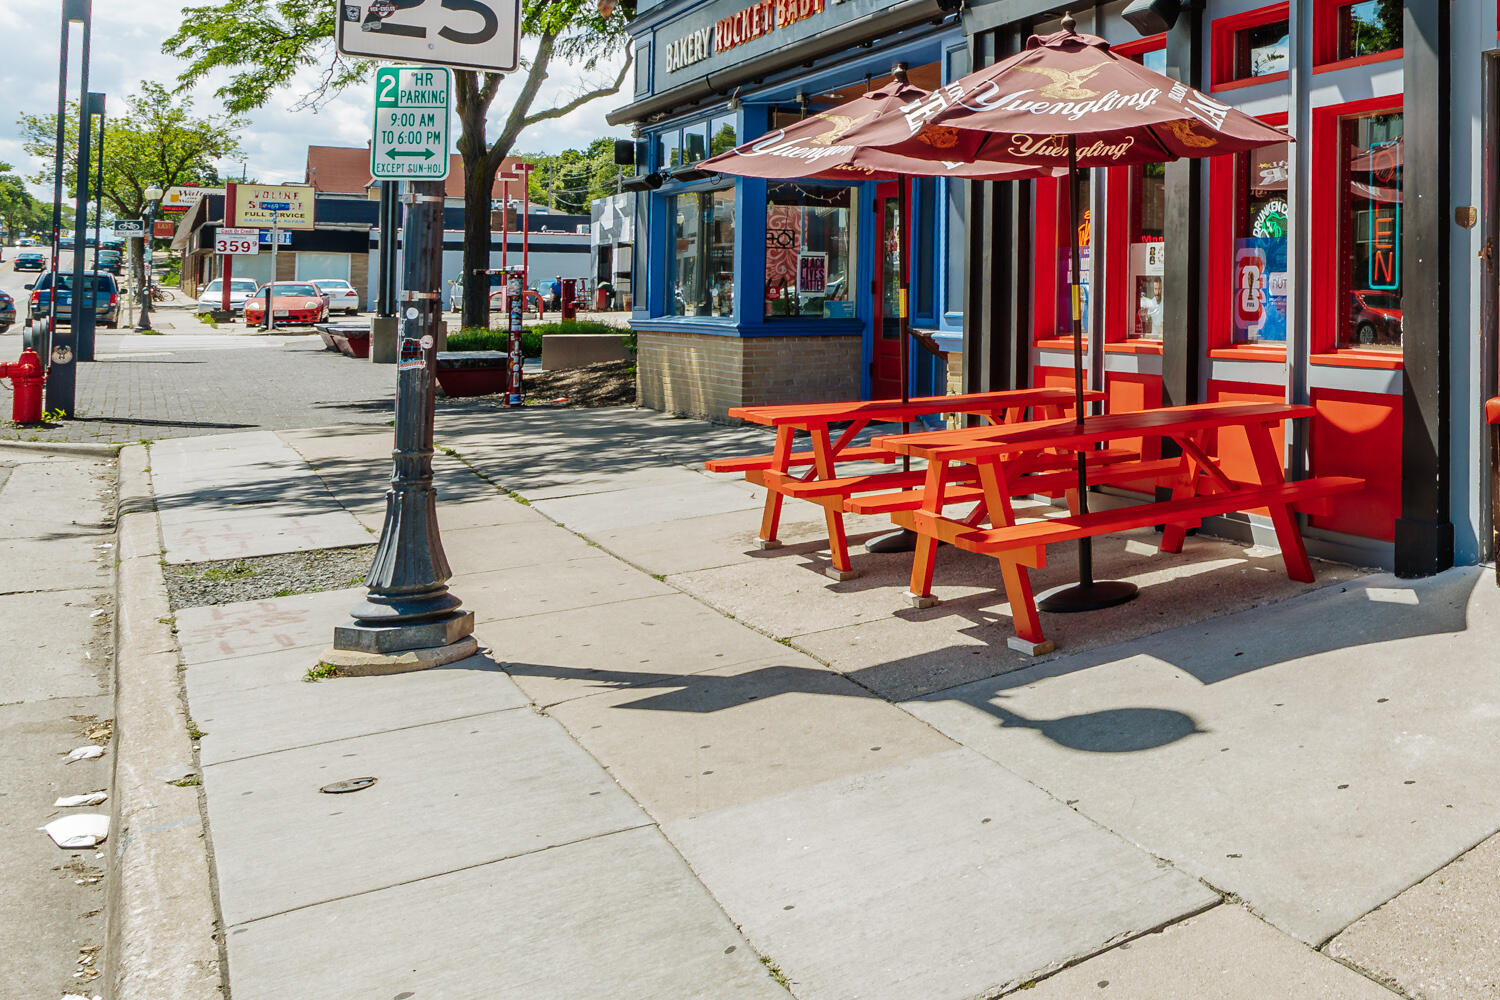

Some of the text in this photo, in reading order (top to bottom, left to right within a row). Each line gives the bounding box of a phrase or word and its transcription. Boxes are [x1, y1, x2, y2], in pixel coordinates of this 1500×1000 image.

[665, 25, 712, 74] BAKERY
[379, 72, 434, 102] 2 HR
[400, 90, 446, 104] PARKING
[391, 113, 435, 128] 9:00 AM
[382, 130, 441, 145] TO 6:00 PM
[376, 162, 443, 174] EXCEPT SUN-HOL
[269, 211, 305, 219] SRVICE
[1252, 200, 1282, 238] DRUNKEN
[1374, 150, 1395, 283] OPEN
[216, 240, 251, 253] 359
[800, 257, 825, 269] BLACK
[800, 267, 825, 280] LIVES
[800, 278, 825, 291] MATTER
